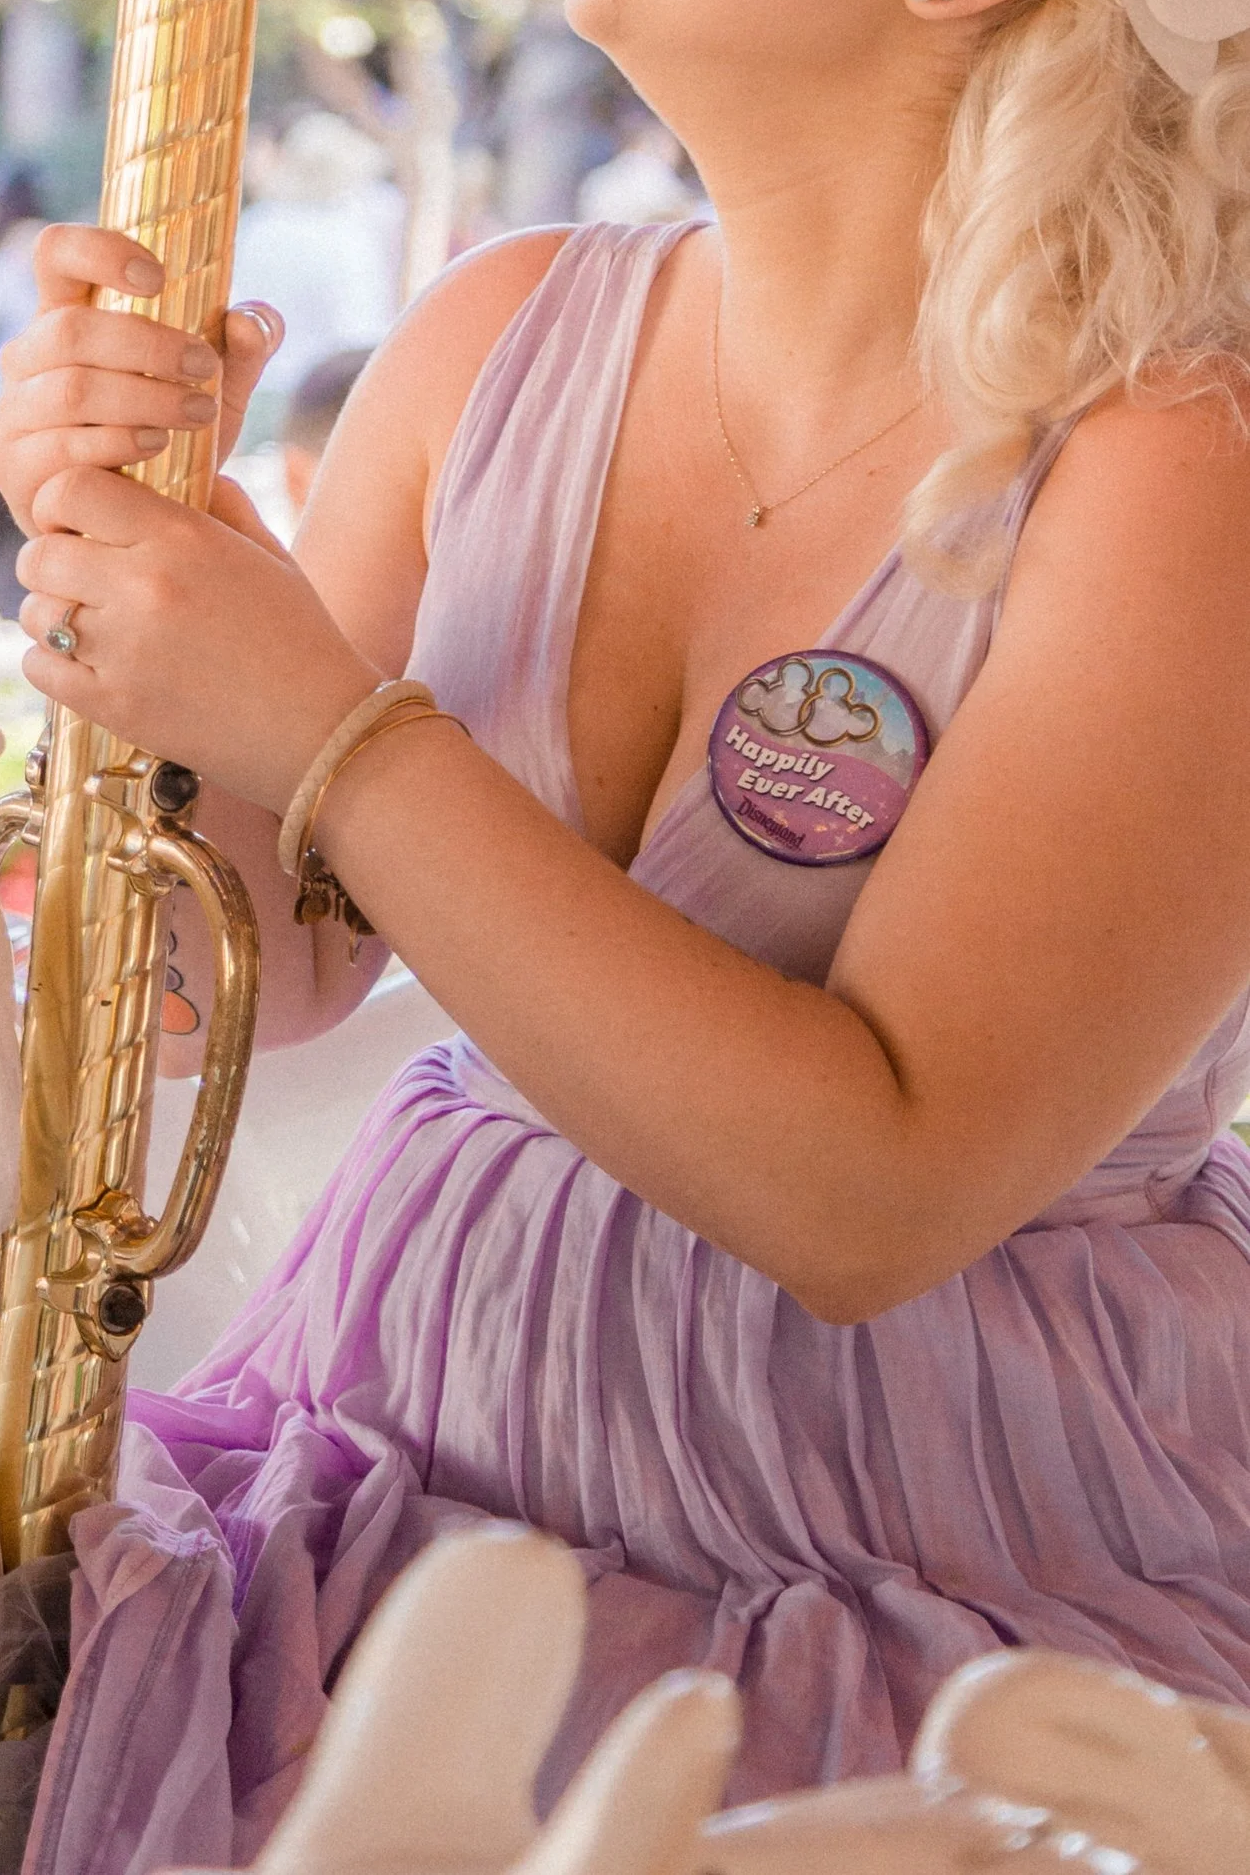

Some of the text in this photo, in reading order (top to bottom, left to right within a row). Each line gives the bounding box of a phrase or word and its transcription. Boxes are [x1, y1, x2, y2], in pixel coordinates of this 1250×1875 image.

[726, 724, 835, 781] Happily
[737, 768, 875, 829] Ever After
